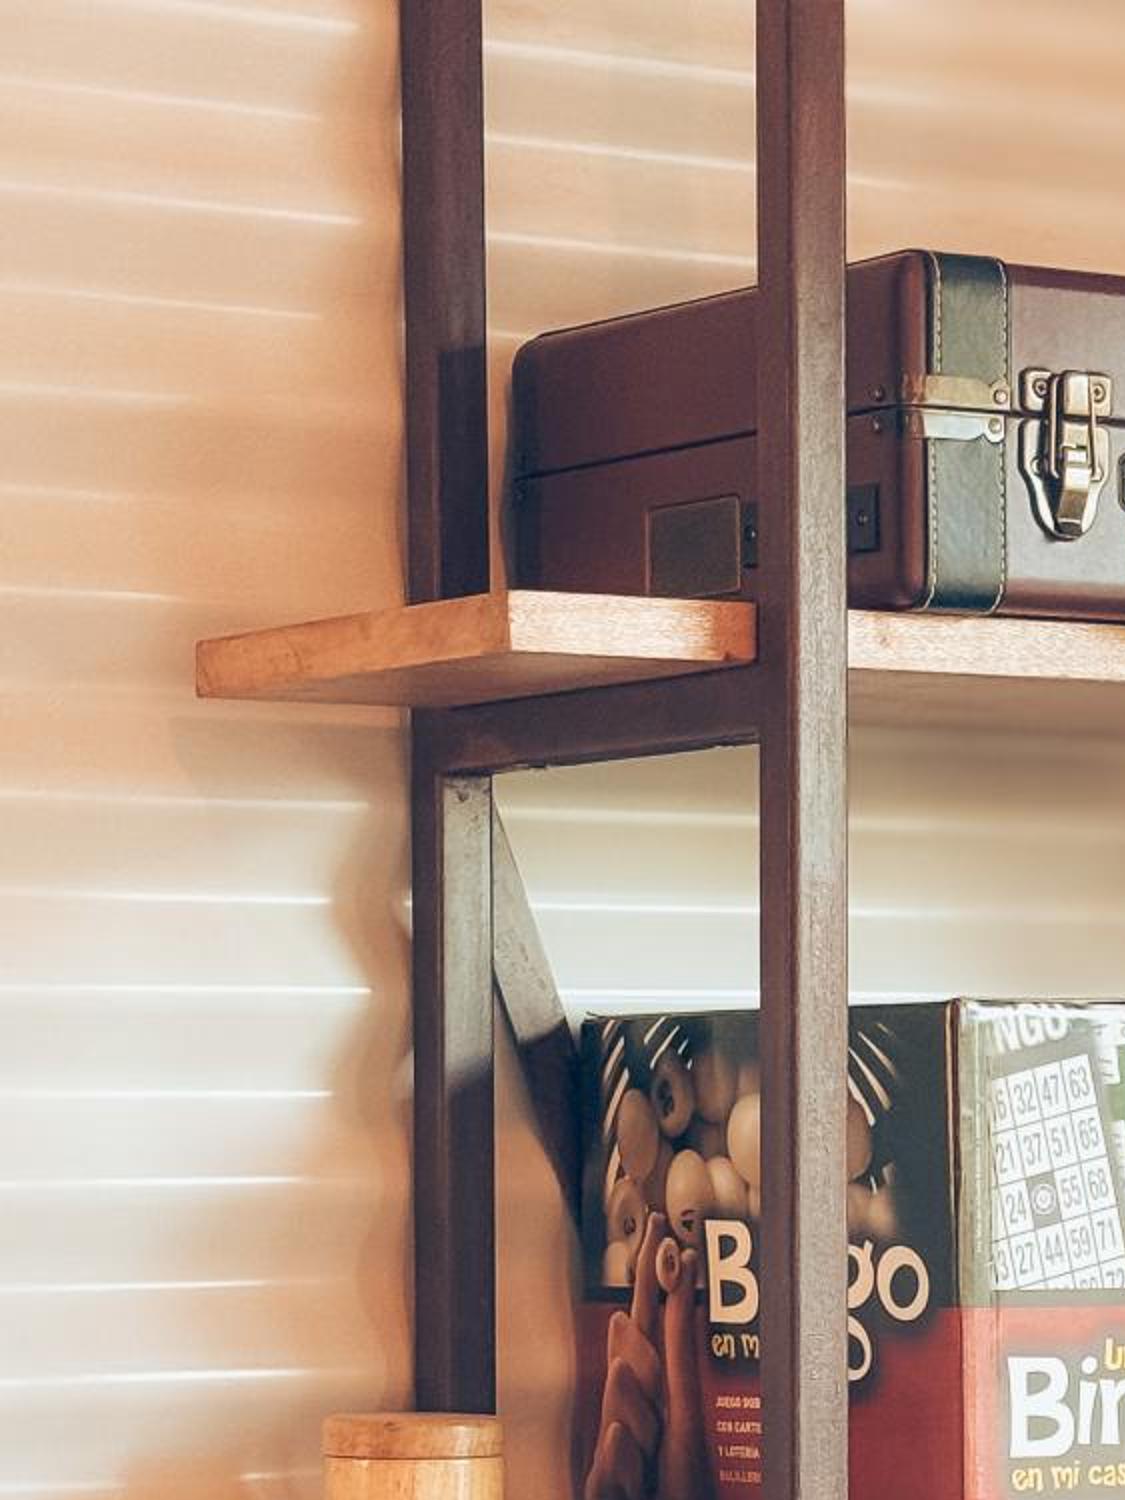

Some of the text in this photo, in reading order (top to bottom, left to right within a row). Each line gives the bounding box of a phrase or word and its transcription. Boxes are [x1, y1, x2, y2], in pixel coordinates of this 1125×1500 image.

[1013, 1082, 1036, 1114] 32
[1042, 1074, 1060, 1101] 47
[1068, 1066, 1091, 1092] 63
[1024, 1134, 1043, 1164] 37
[1051, 1126, 1072, 1156] 51
[1077, 1118, 1100, 1144] 65
[1005, 1192, 1027, 1224] 24
[1087, 1169, 1110, 1199] 68
[1019, 1244, 1038, 1275] 27
[742, 1334, 760, 1360] m
[1012, 1468, 1043, 1493] en
[1051, 1461, 1080, 1489] mi
